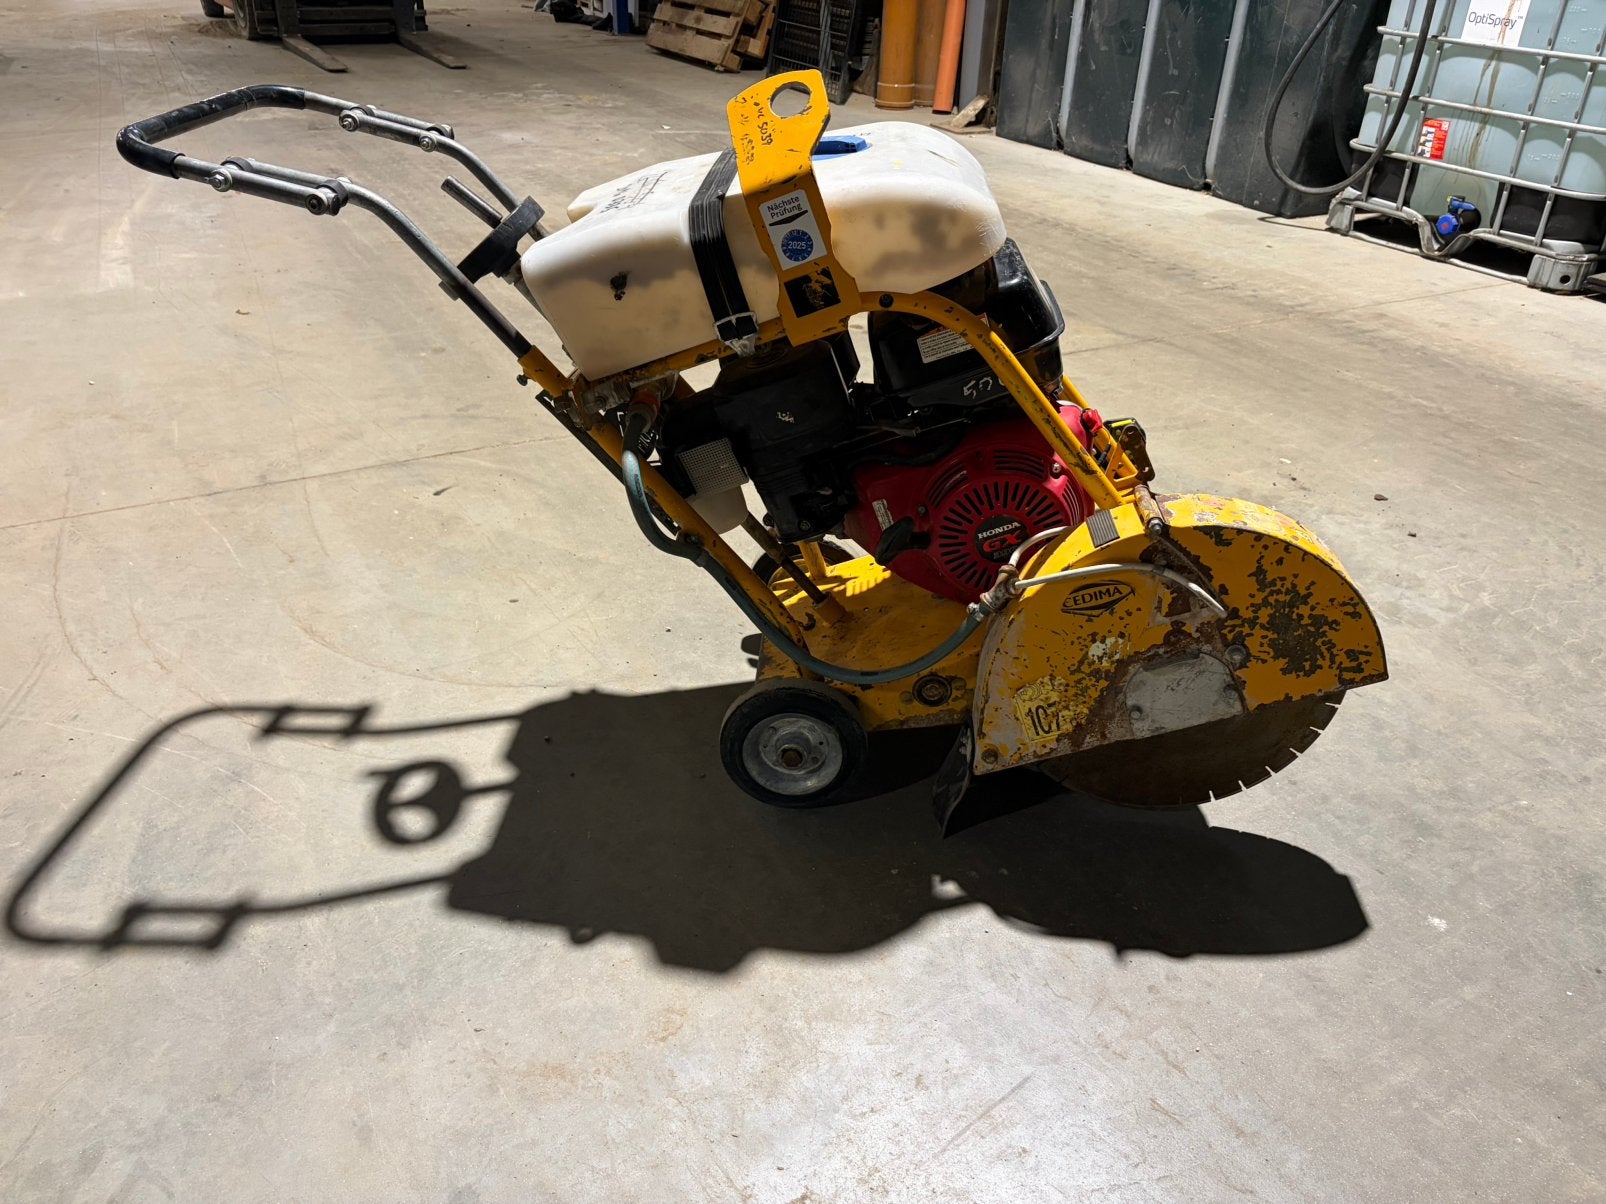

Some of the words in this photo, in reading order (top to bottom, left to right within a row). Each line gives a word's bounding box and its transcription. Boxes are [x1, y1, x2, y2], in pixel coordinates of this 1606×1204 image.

[766, 196, 800, 213] Nächste
[770, 203, 803, 220] Prüfung
[787, 241, 807, 250] 2025
[977, 521, 1022, 540] HONDA
[983, 529, 1023, 553] GX
[1062, 585, 1123, 608] CEDIMA
